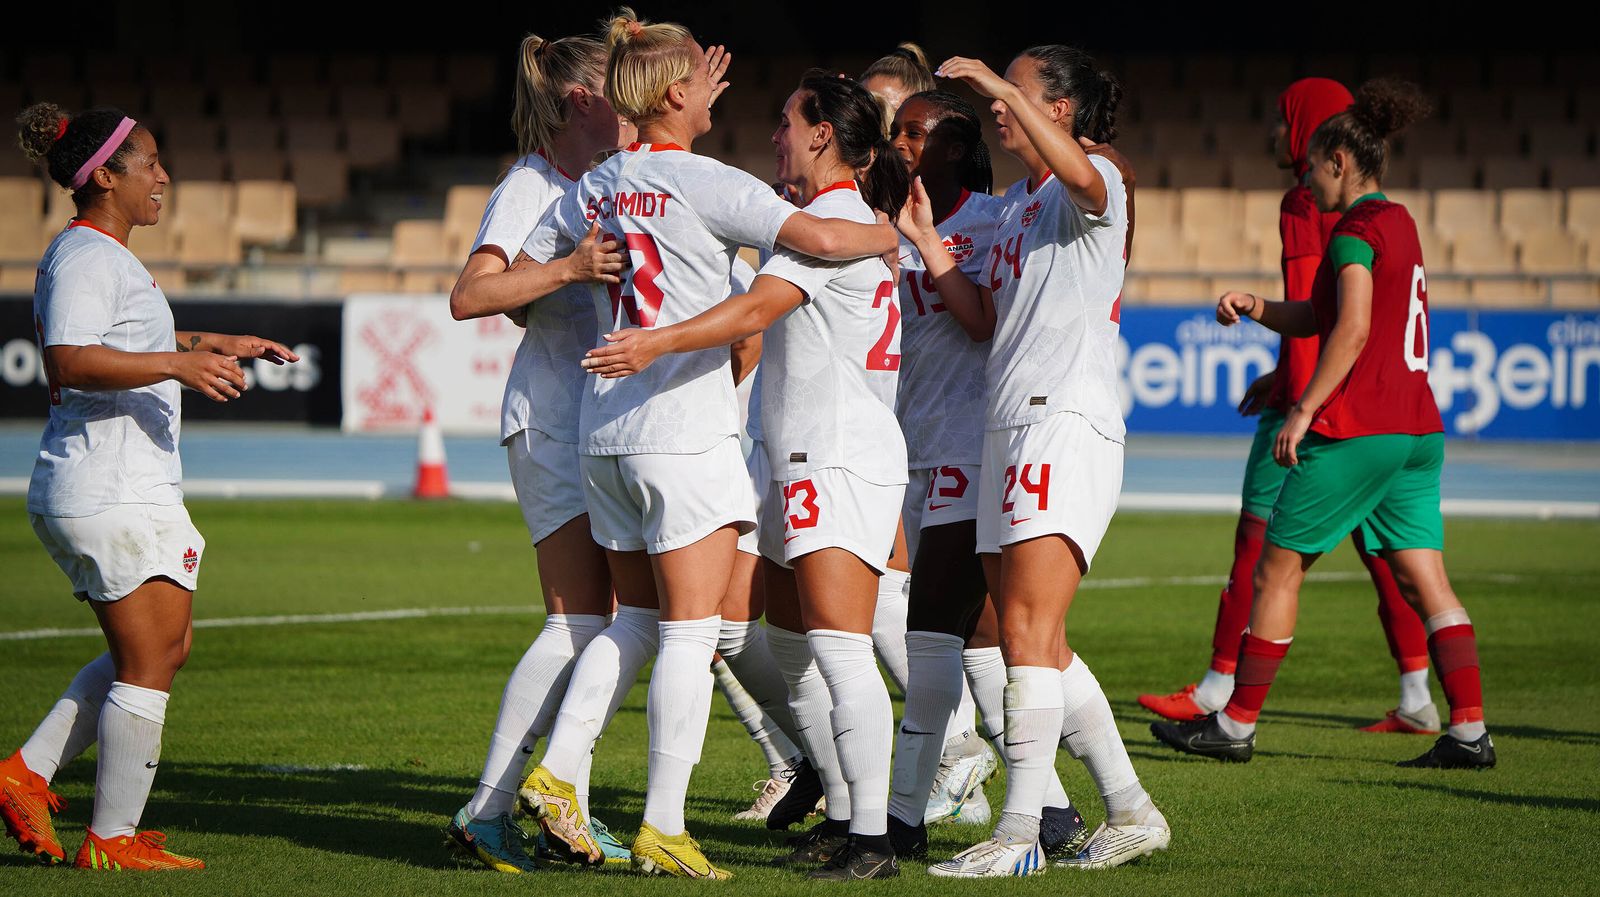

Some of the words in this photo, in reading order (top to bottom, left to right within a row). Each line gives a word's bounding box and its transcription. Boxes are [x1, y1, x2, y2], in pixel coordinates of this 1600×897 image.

[586, 192, 672, 220] SCHMIDT
[947, 243, 974, 252] ANADA
[990, 232, 1024, 293] 24
[1403, 264, 1429, 373] 6
[1117, 334, 1278, 420] eim
[1002, 463, 1051, 514] 24
